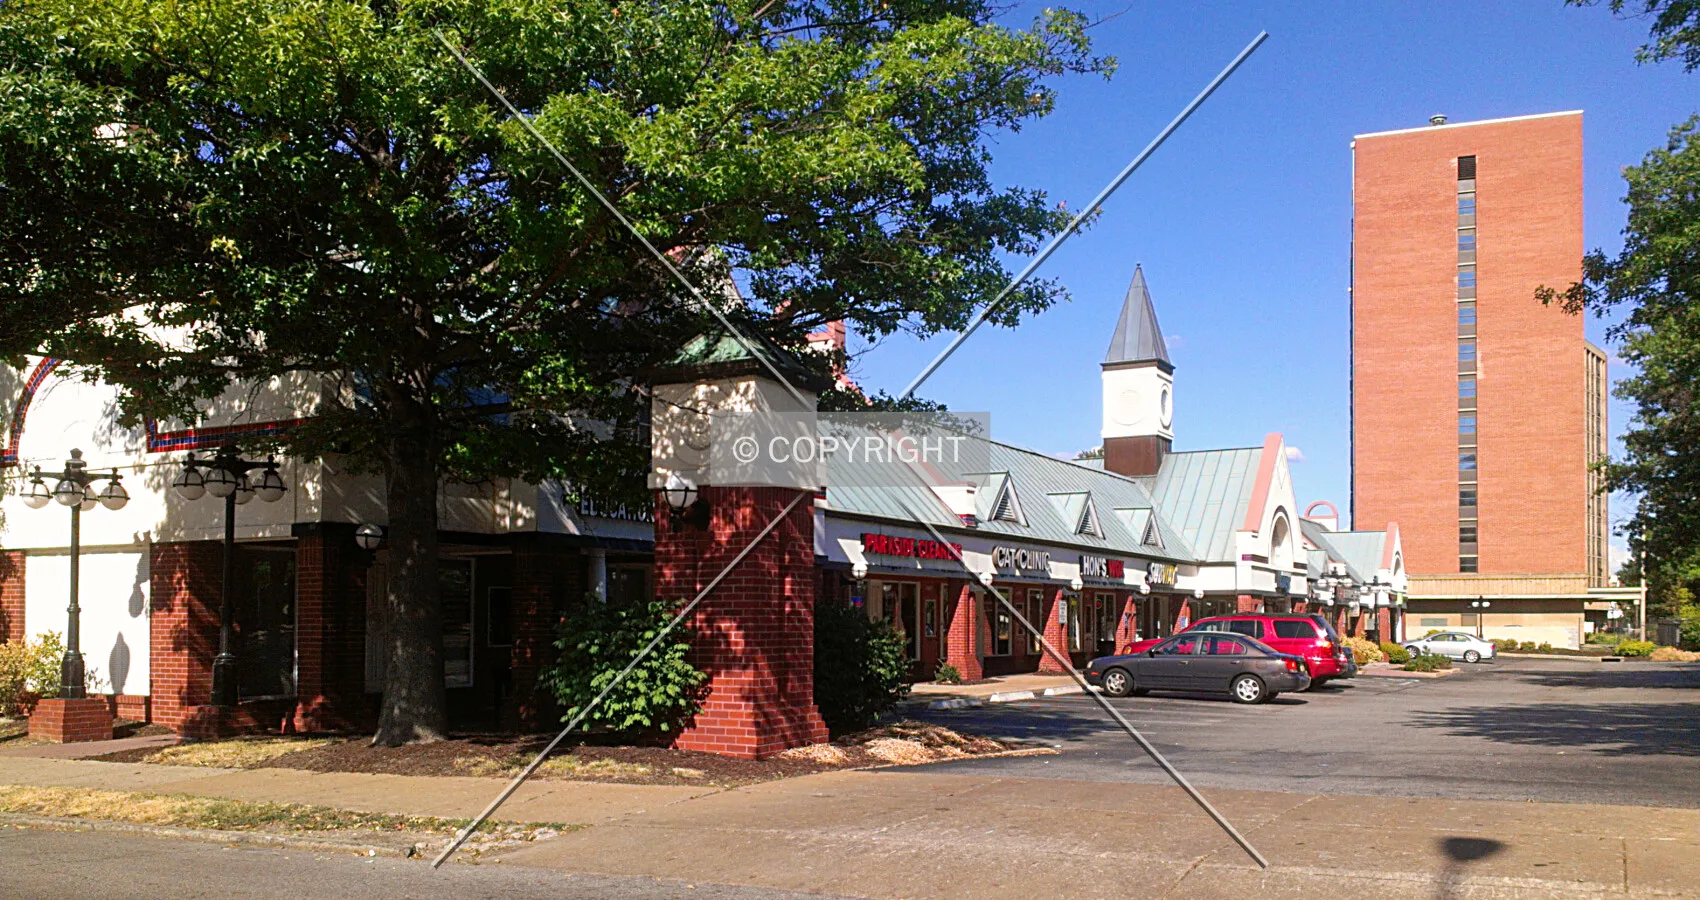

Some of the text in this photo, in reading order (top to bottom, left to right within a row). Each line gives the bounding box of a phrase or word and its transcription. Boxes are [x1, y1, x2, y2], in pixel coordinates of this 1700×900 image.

[864, 533, 915, 557] PARKSIDE
[996, 546, 1051, 571] CAT CLINIC
[1082, 555, 1107, 578] HON'S
[1148, 562, 1178, 585] SUBWAY
